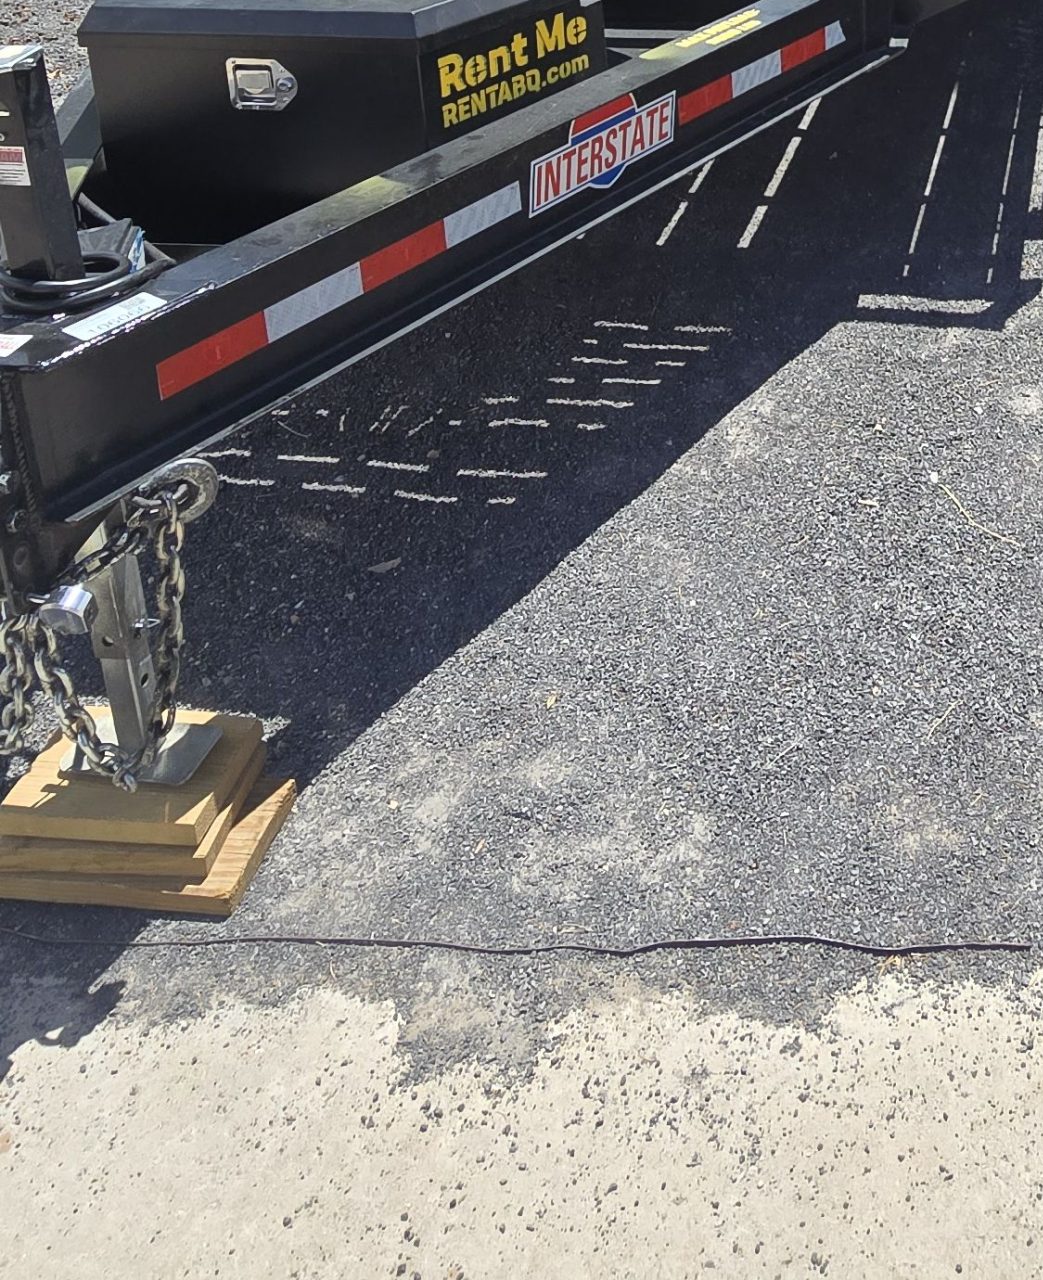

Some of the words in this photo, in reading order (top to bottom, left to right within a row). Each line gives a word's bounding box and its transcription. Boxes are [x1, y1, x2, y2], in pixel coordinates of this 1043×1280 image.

[437, 33, 528, 98] Rent
[535, 12, 587, 59] Me
[441, 54, 589, 128] RENTABQ.com
[535, 100, 670, 207] INTERSTATE
